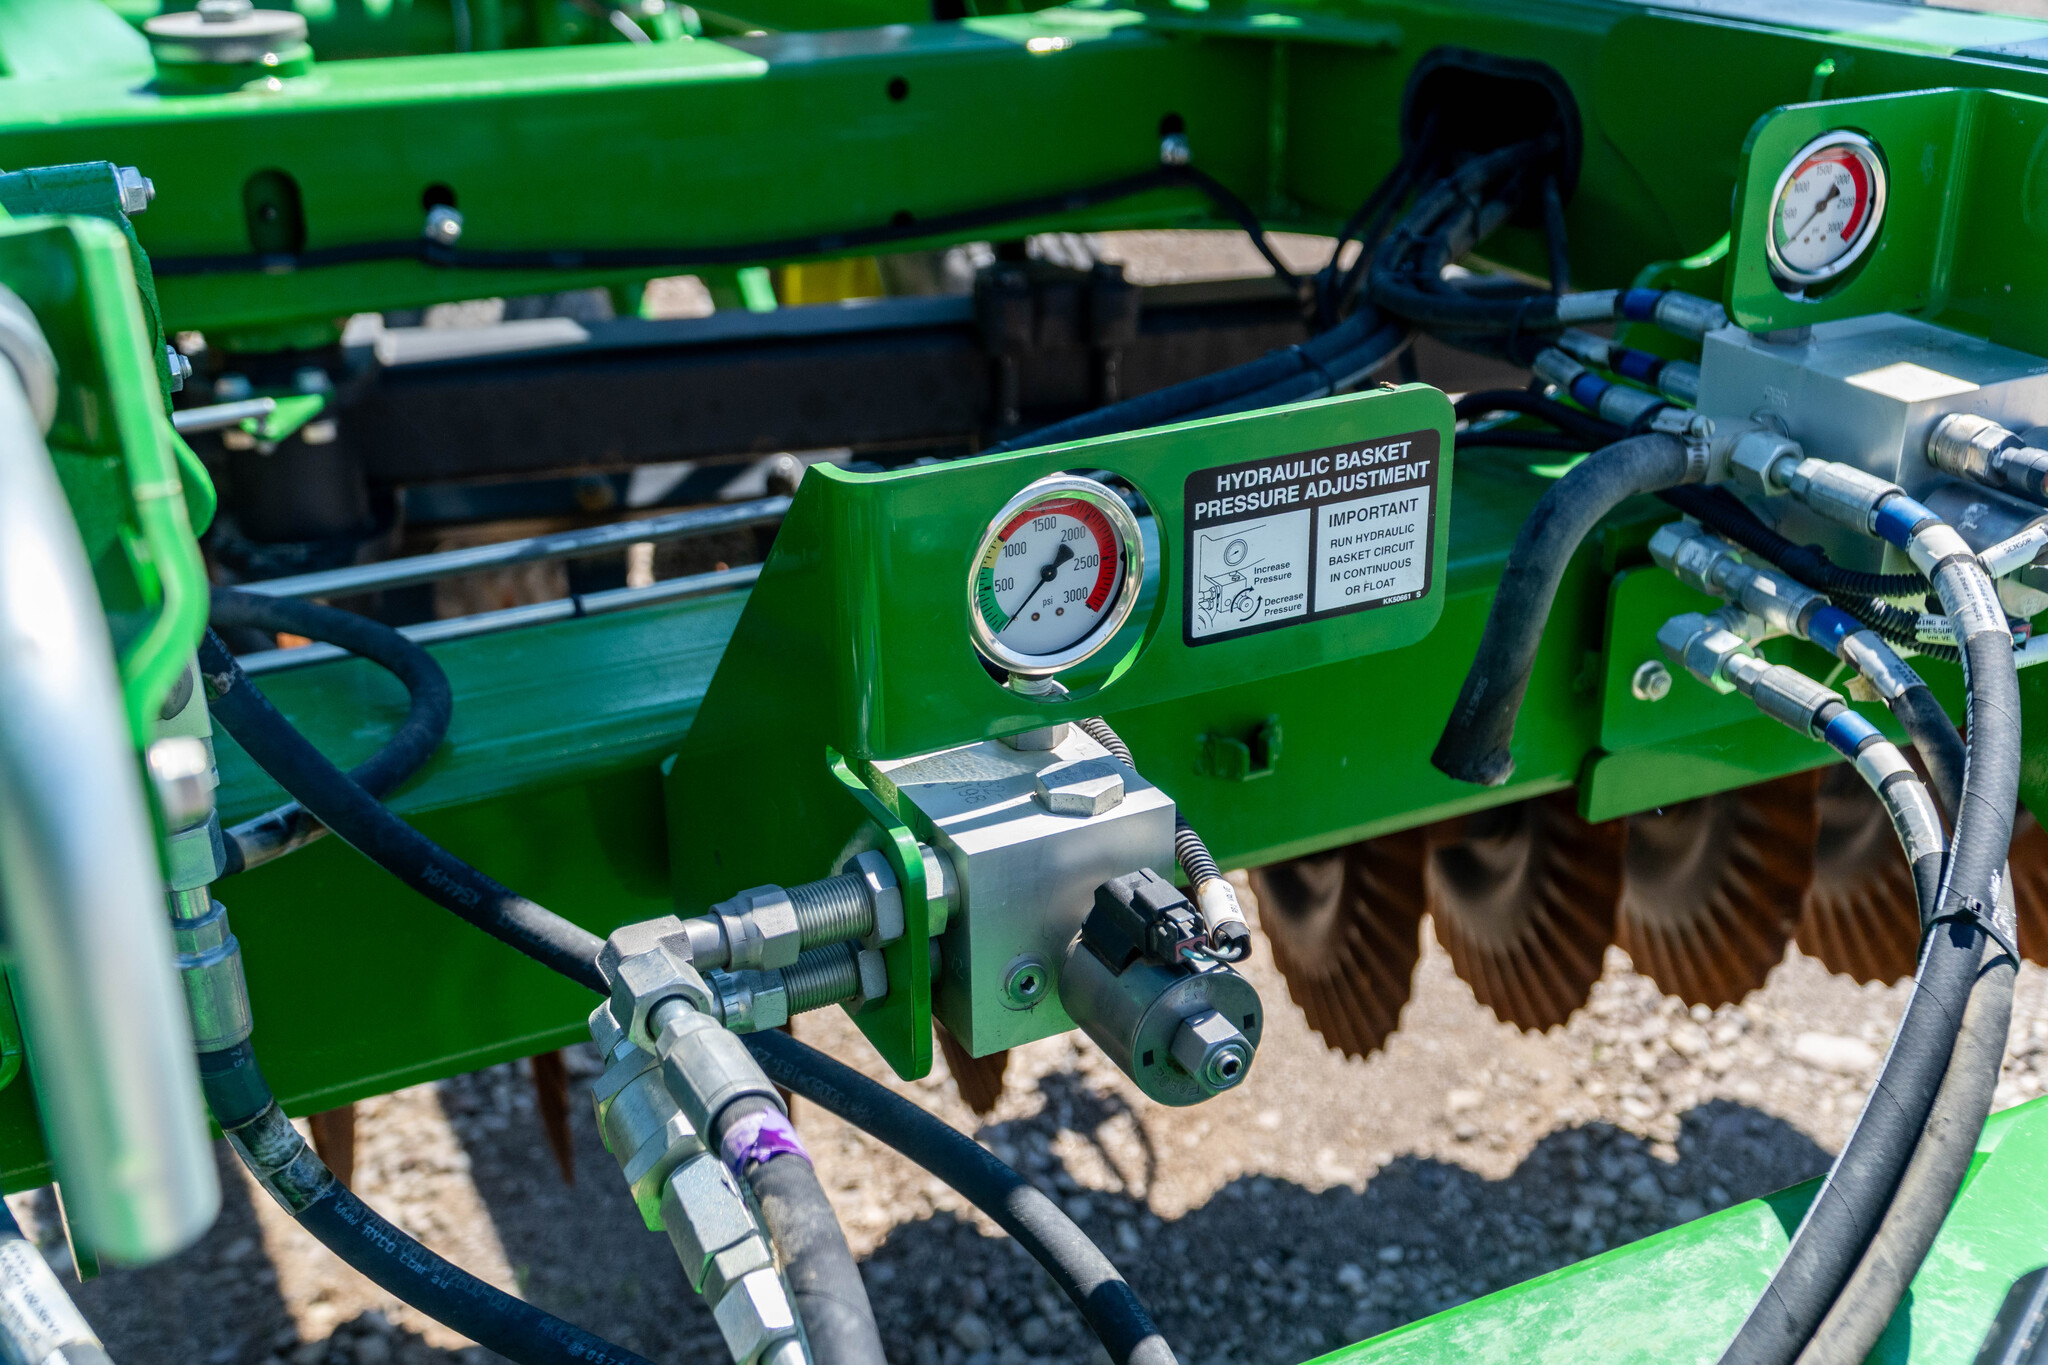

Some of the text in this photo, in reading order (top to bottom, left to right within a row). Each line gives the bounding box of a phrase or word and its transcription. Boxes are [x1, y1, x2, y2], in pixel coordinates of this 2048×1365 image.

[1217, 441, 1412, 493] HYDRAULIC BASKET
[1195, 460, 1431, 520] PRESSURE ADJUSTMENT
[1329, 498, 1419, 528] IMPORTANT
[1032, 516, 1057, 533] 1500
[1061, 525, 1087, 543] 2000
[1330, 523, 1415, 549] RUN HYDRAULIC
[1002, 541, 1027, 558] 1000
[1329, 540, 1415, 566] BASKET CIRCUIT
[1073, 554, 1099, 571] 2500
[1254, 562, 1291, 575] Increase
[1330, 557, 1412, 583] IN CONTINUOUS
[994, 577, 1014, 593] 500
[1254, 572, 1292, 585] Pressure
[1345, 577, 1397, 596] OR FLOAT
[1042, 595, 1054, 608] psi
[1063, 586, 1088, 604] 3000
[1264, 592, 1304, 607] Decrease
[1264, 603, 1302, 617] Pressure
